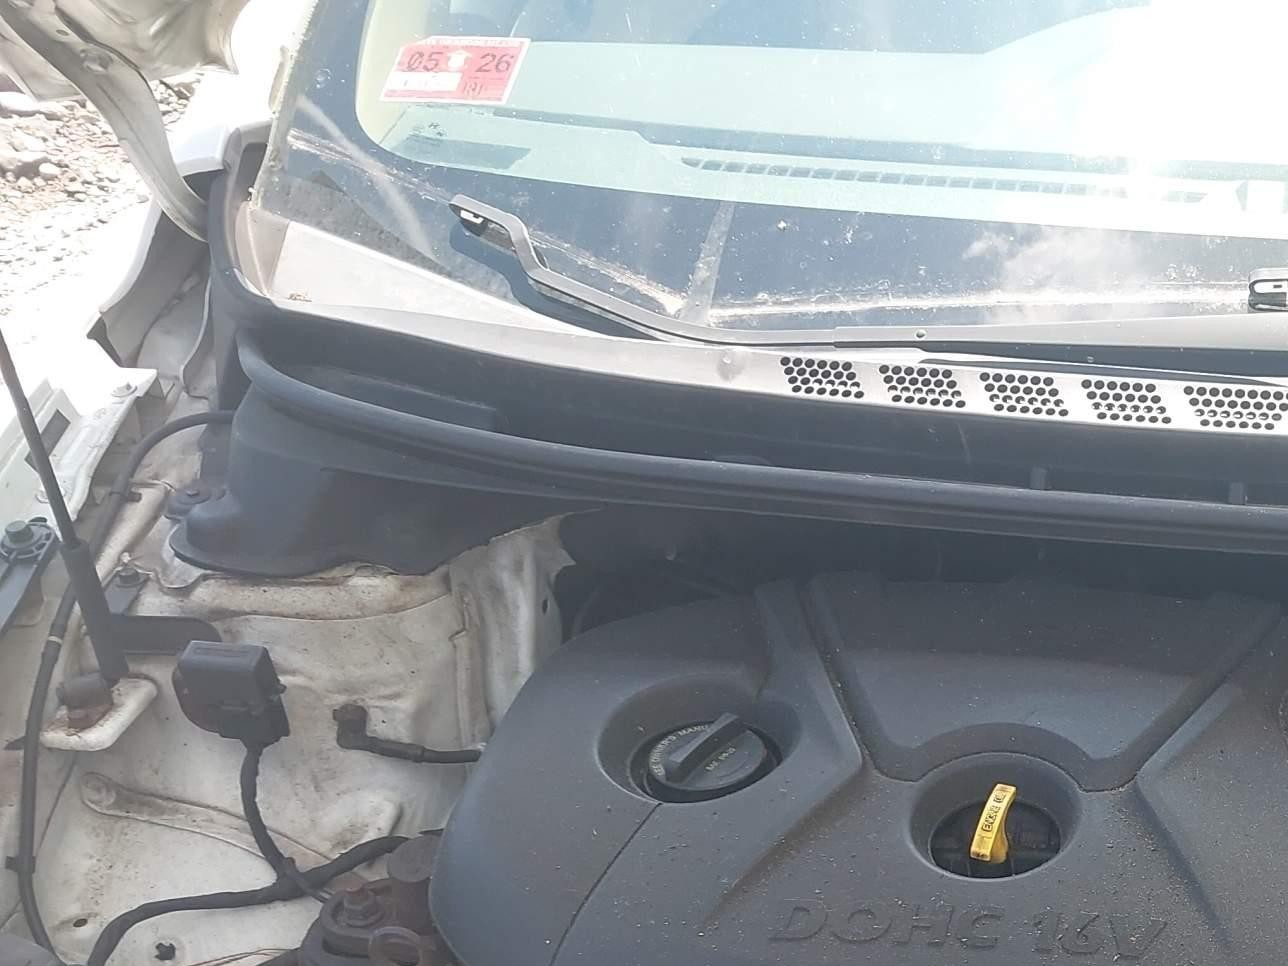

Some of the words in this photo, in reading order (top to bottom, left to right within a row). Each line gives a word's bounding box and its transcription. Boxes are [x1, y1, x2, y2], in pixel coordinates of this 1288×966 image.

[406, 51, 444, 72] 05
[475, 52, 514, 73] 26
[677, 725, 709, 736] MANU
[981, 805, 1001, 832] ENGINE
[768, 899, 1004, 949] DOHC
[1032, 908, 1168, 960] 16V
